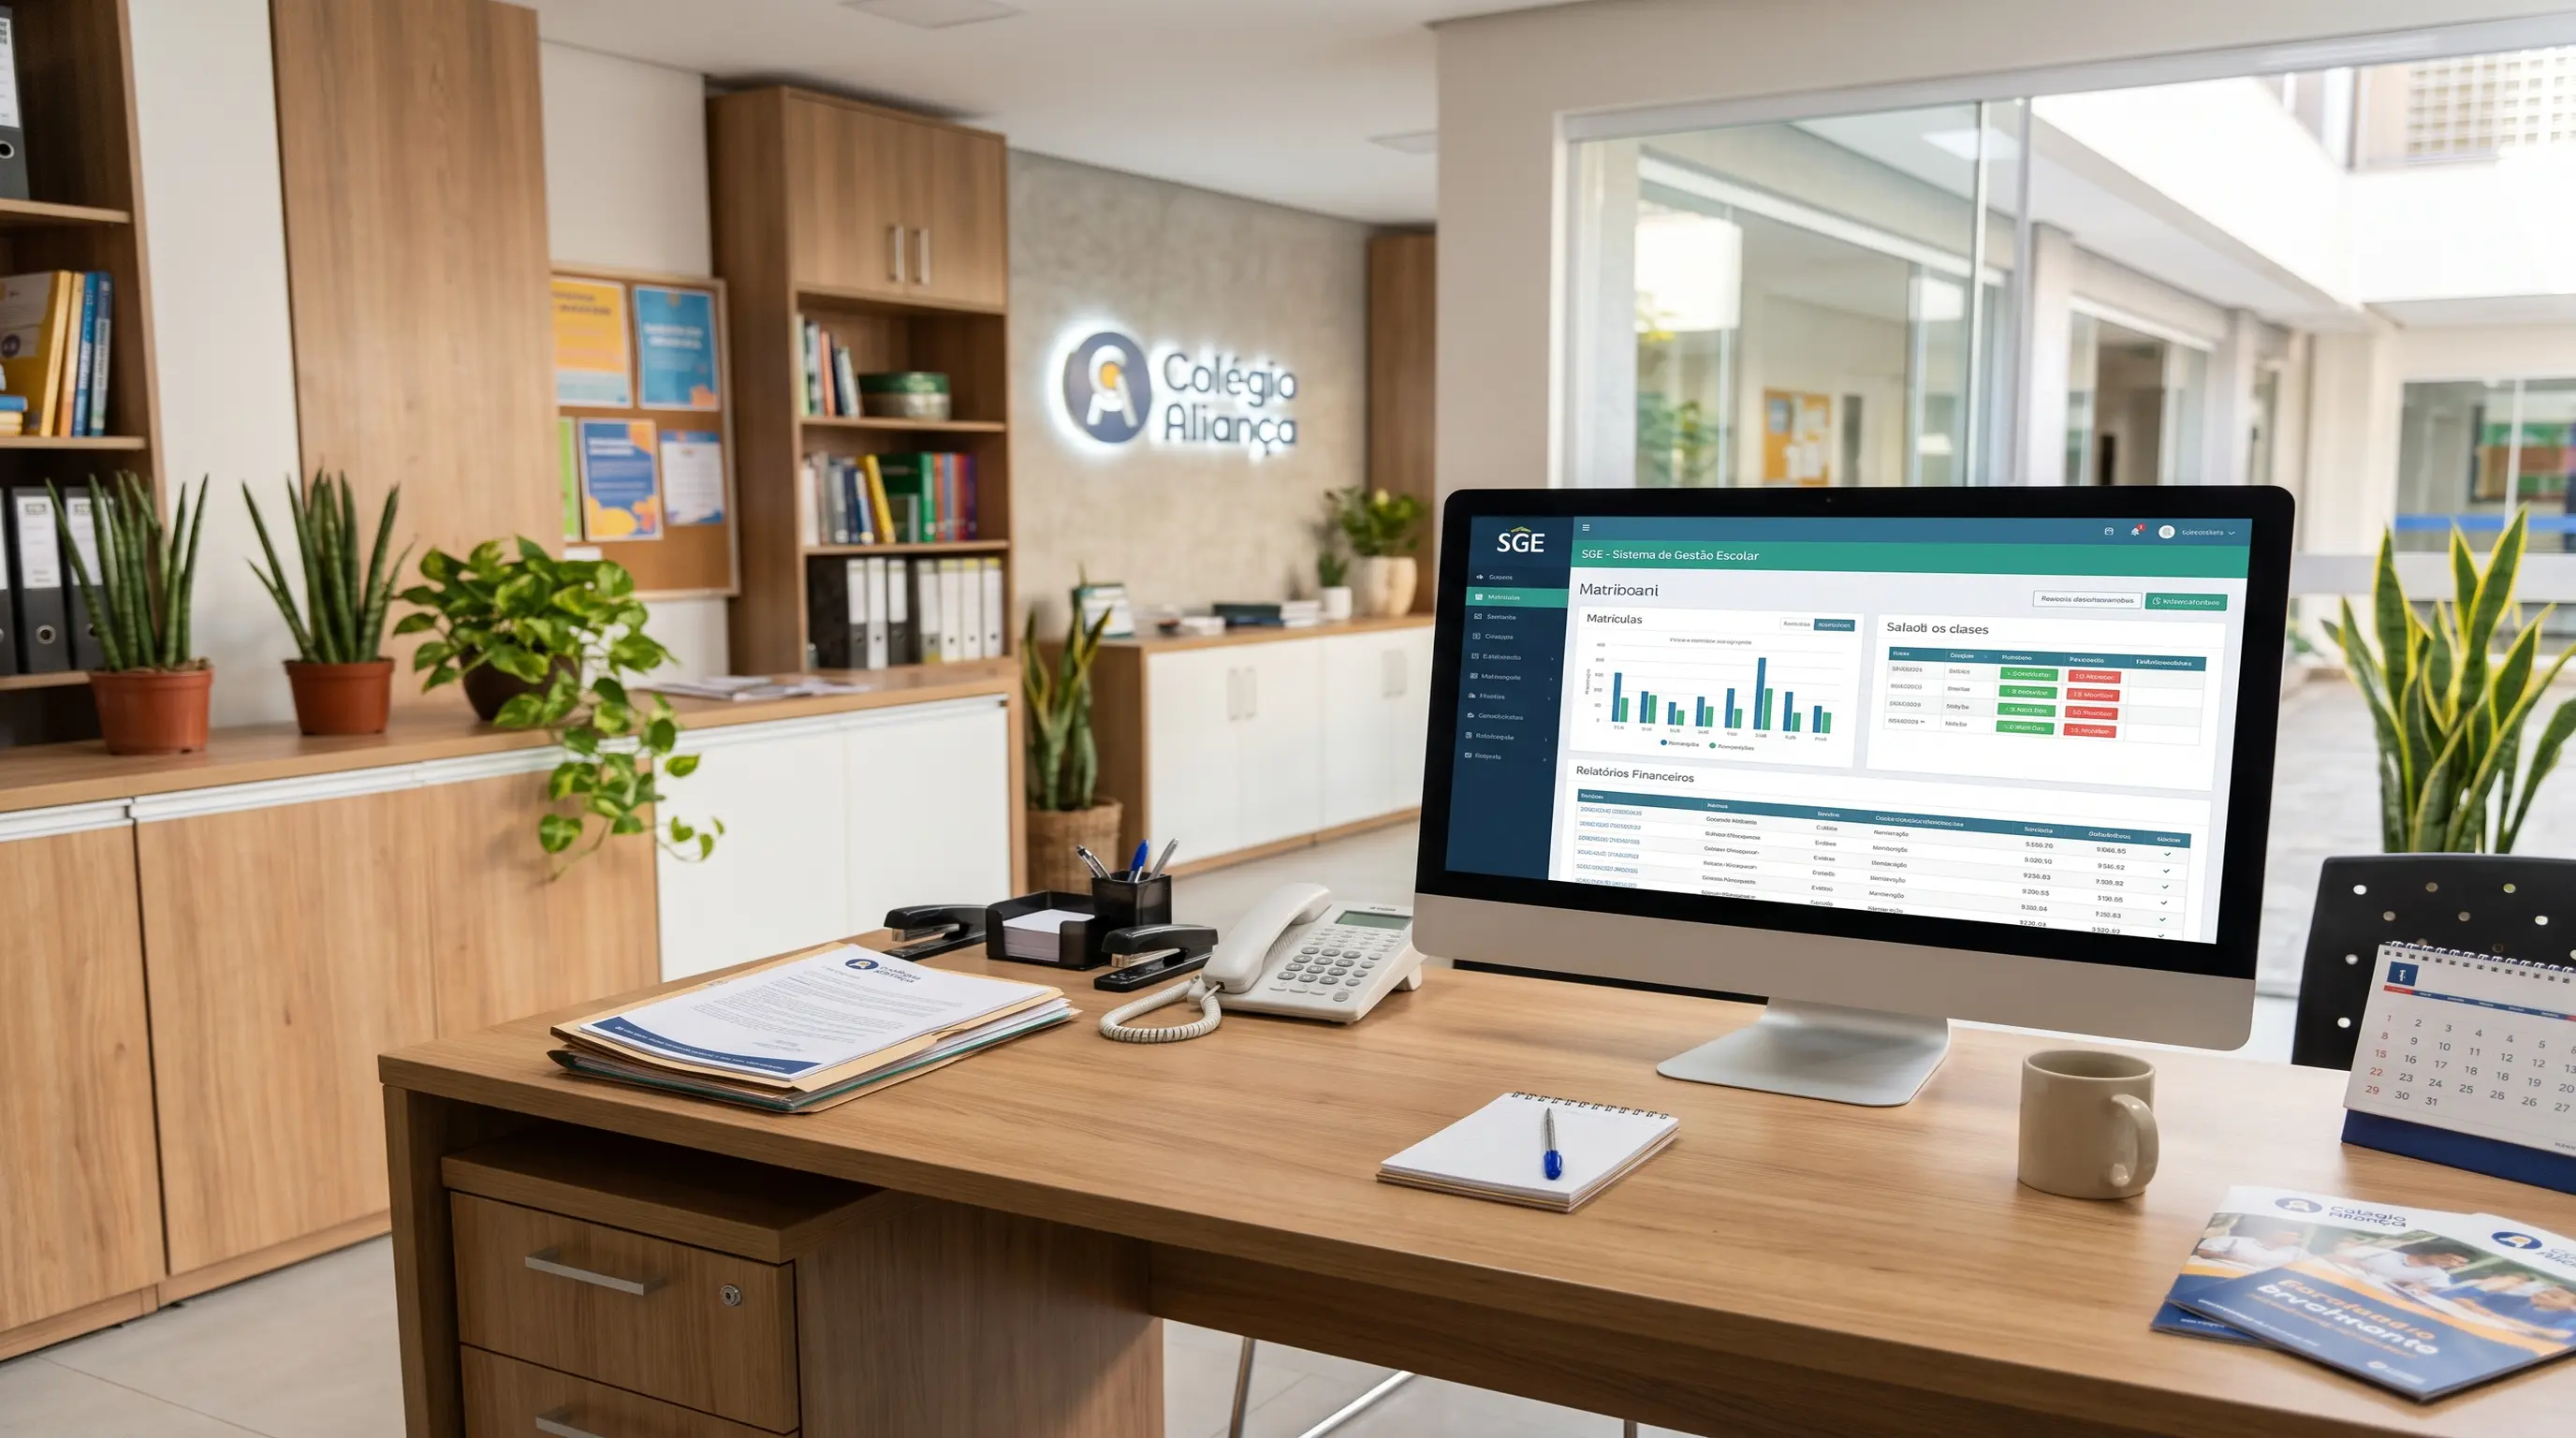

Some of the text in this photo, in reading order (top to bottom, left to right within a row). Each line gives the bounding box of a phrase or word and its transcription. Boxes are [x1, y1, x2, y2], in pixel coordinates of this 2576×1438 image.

[1163, 352, 1297, 408] Colégio
[1164, 403, 1297, 457] Aliança
[1497, 532, 1545, 553] SGE
[1581, 549, 1603, 559] SGE
[1612, 550, 1656, 560] Sistema
[1658, 550, 1672, 560] de
[1674, 549, 1714, 561] Gestão
[1716, 550, 1760, 562] Escolar
[1931, 624, 1947, 634] os
[1576, 766, 1695, 783] Relatórios Financeiros
[2415, 1019, 2422, 1028] 2
[2445, 1024, 2452, 1033] 3
[2475, 1029, 2482, 1037] 4
[2539, 1040, 2546, 1049] 5
[2381, 1032, 2576, 1074] 8 9 10 11 12 12 13
[2375, 1049, 2575, 1093] 15 16 17 18 18 19 20
[2365, 1085, 2437, 1107] 29 30 31
[2369, 1066, 2570, 1112] 22 23 24 25 26 26 27
